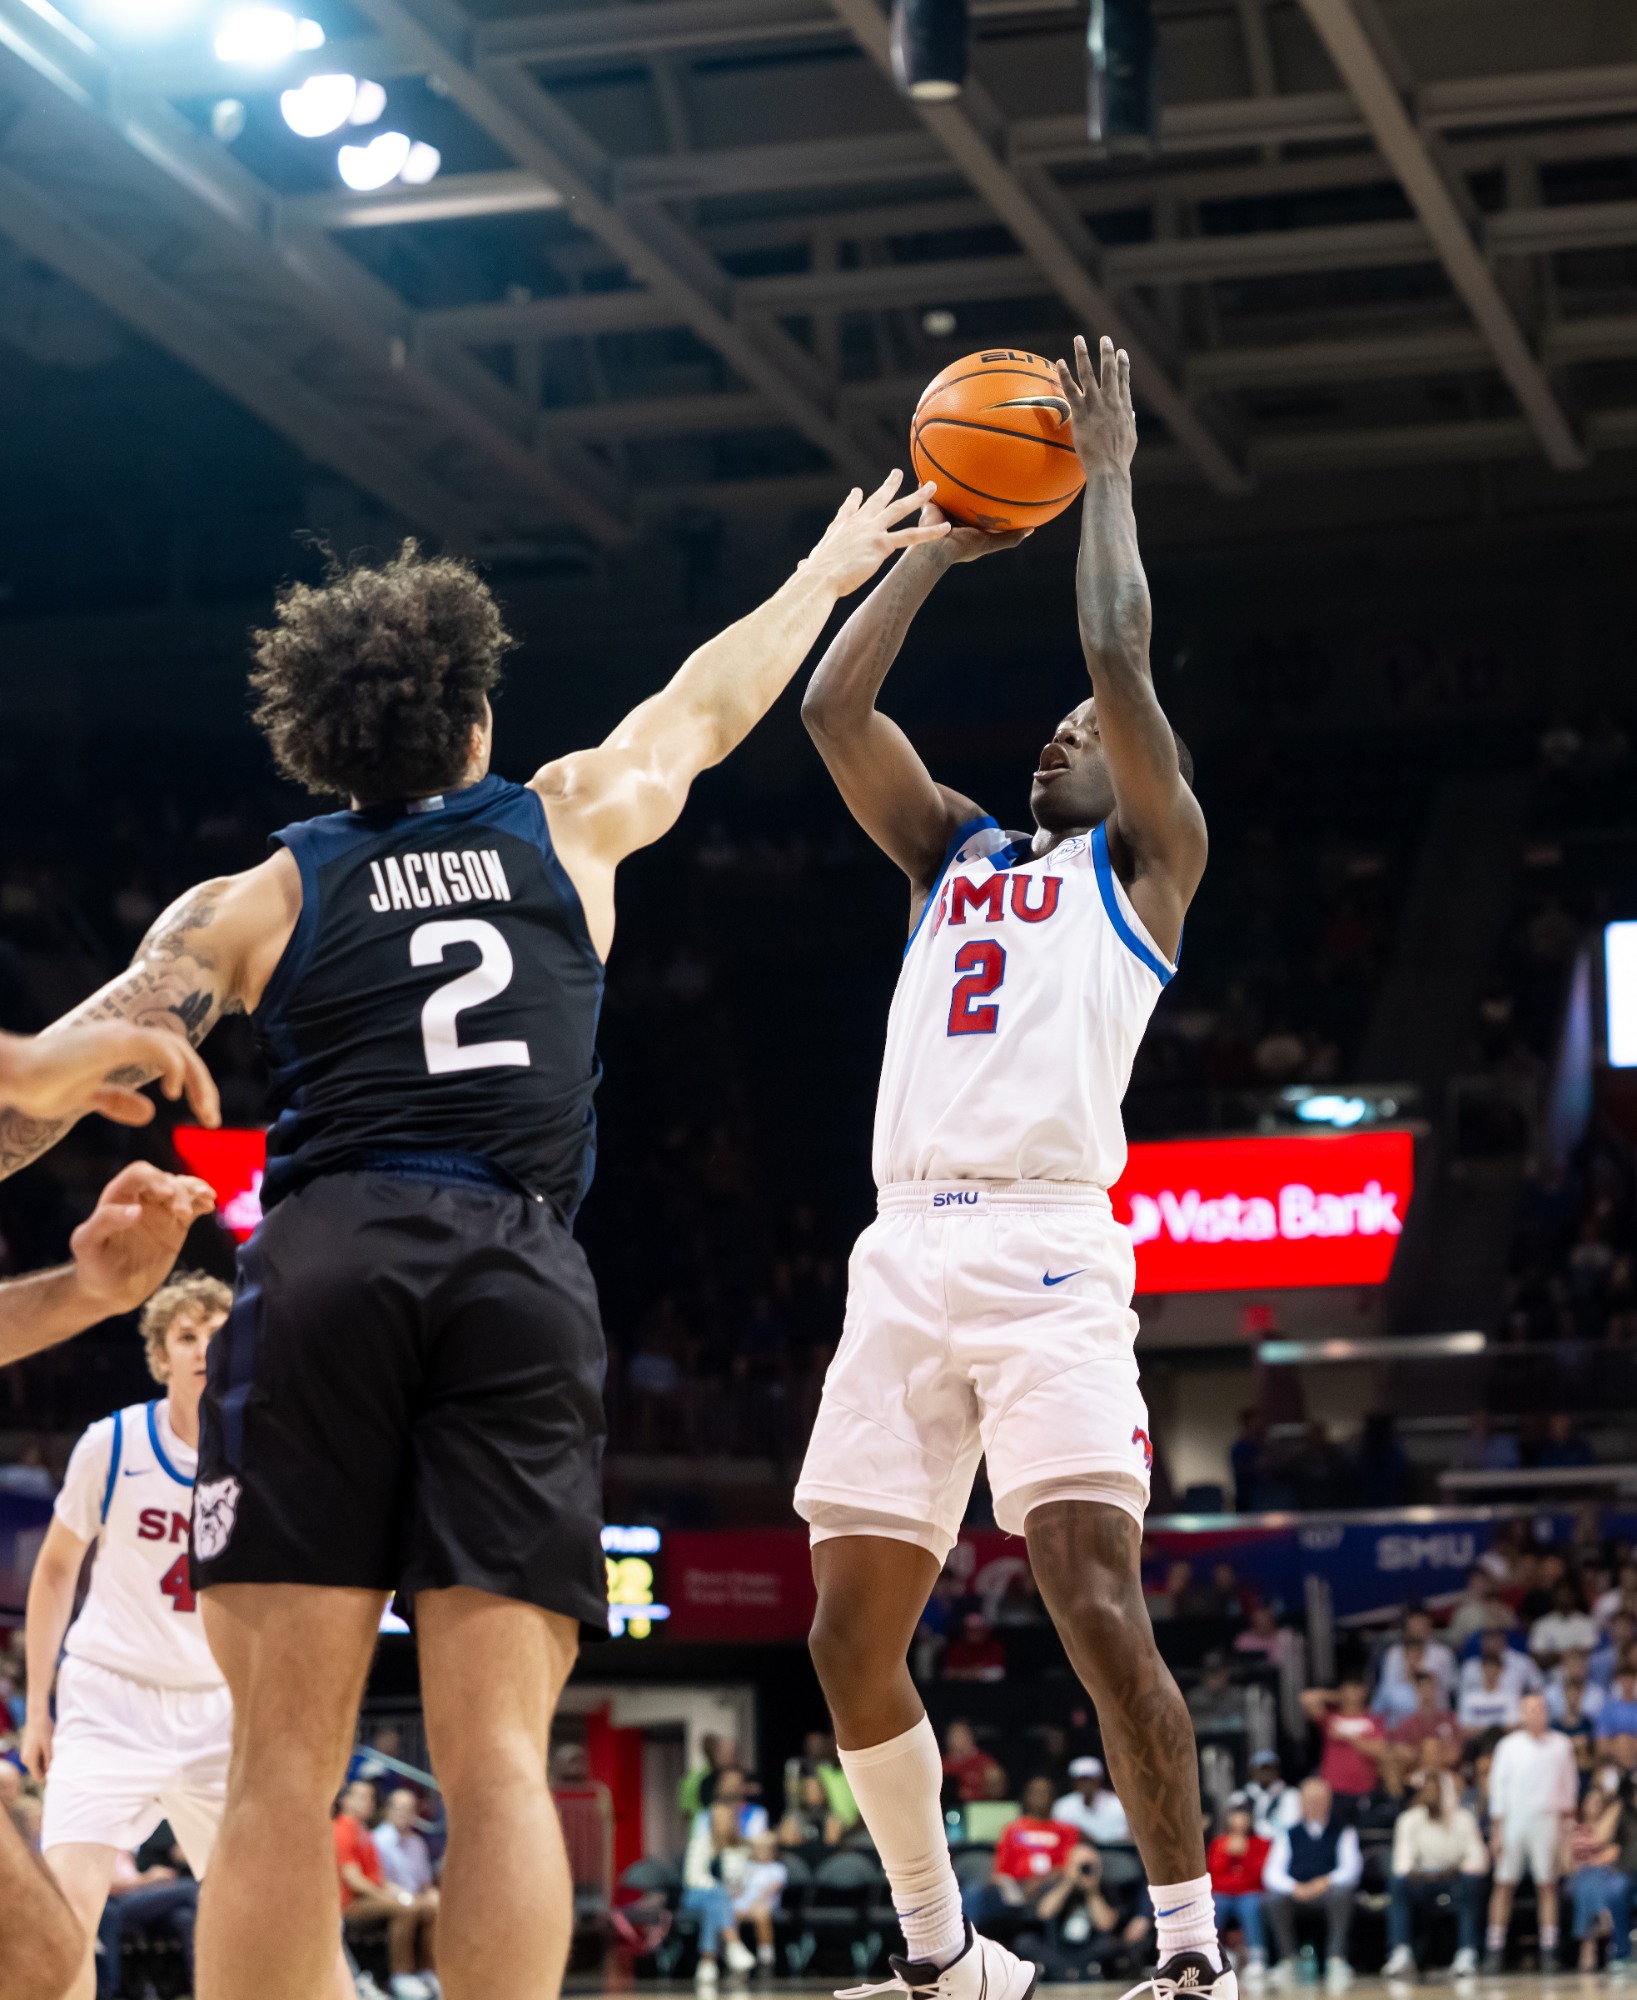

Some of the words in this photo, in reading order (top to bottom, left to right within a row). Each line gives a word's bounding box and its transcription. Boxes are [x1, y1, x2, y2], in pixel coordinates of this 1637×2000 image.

[980, 351, 1058, 374] ELIT
[369, 850, 511, 912] JACKSON
[409, 918, 531, 1075] 2
[947, 939, 1007, 1037] 2
[933, 1191, 979, 1207] SMU
[1279, 1179, 1403, 1240] Bank
[137, 1508, 190, 1544] SM
[1376, 1534, 1475, 1570] SMU
[160, 1552, 197, 1613] 4
